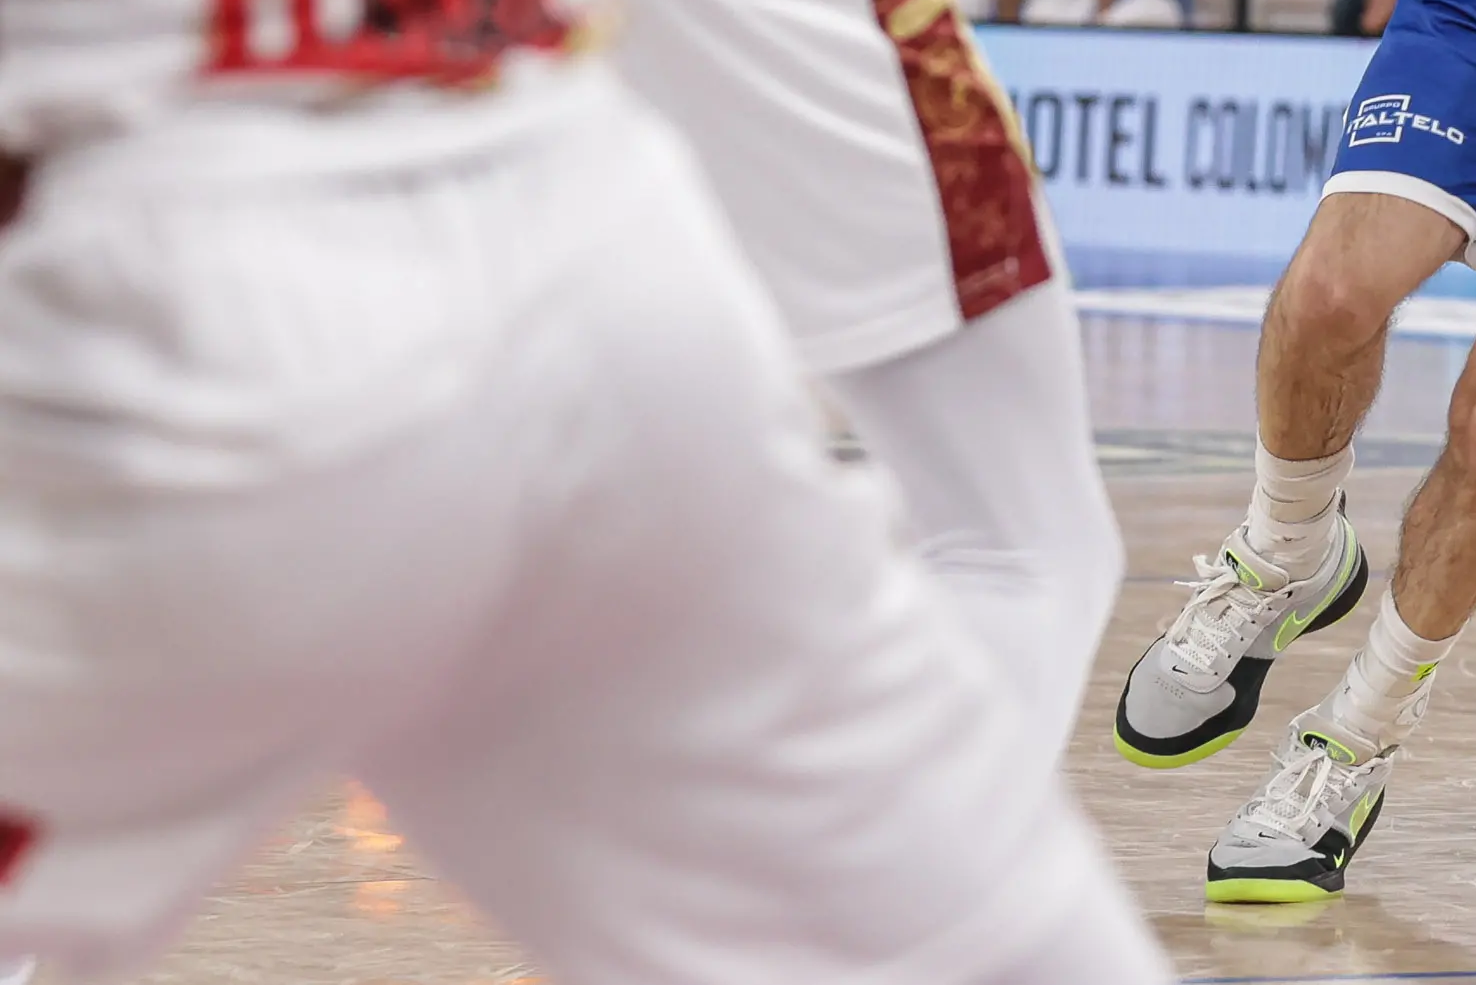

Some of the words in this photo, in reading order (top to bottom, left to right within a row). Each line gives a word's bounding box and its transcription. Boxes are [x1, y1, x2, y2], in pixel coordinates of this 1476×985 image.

[1364, 102, 1400, 112] GRUPPO
[1012, 91, 1166, 188] OTEL
[1347, 111, 1465, 145] ITALTELO
